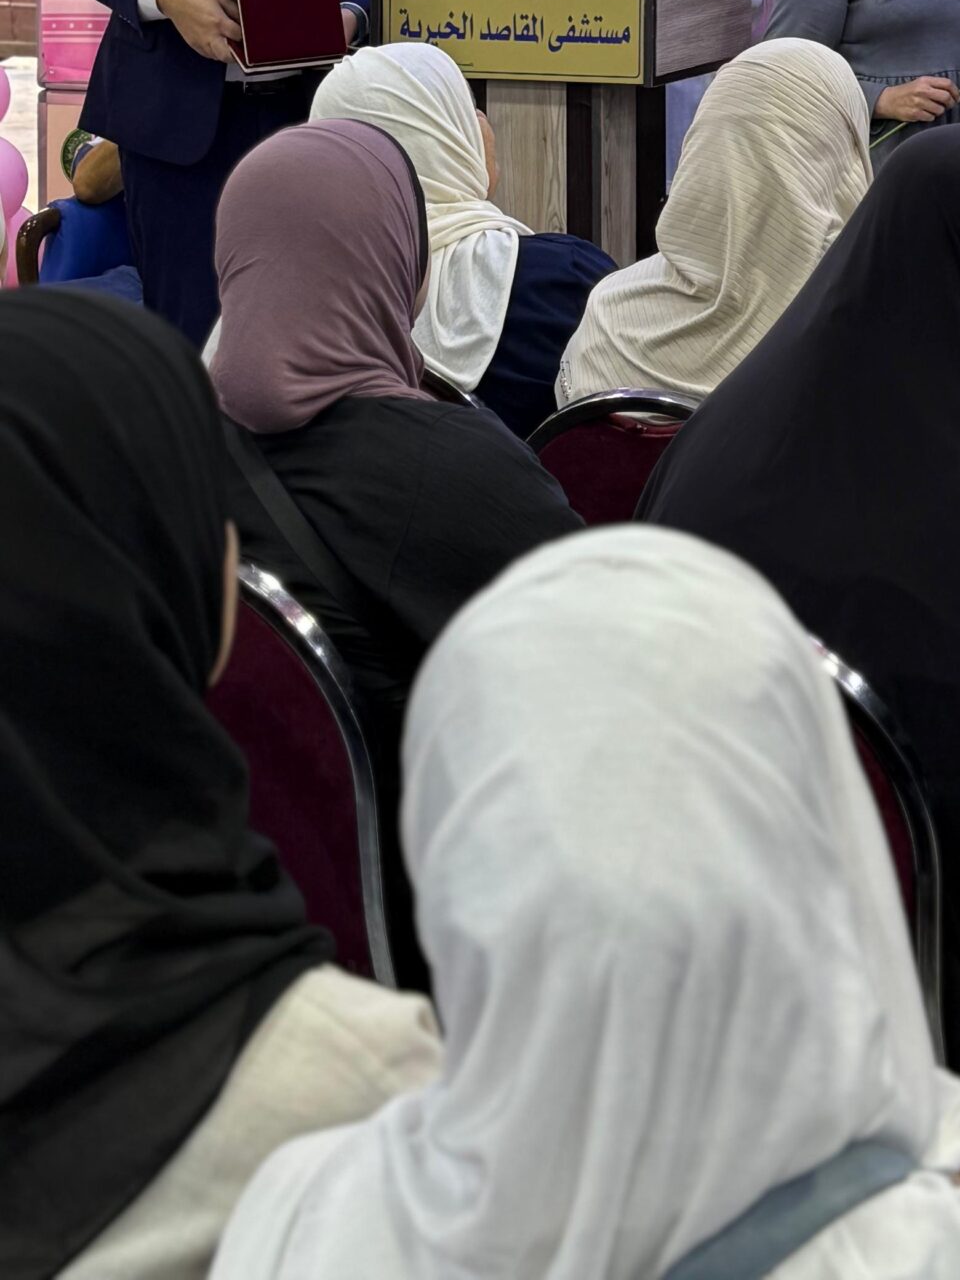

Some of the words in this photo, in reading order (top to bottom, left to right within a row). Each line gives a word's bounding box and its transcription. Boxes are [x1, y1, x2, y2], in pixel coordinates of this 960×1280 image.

[400, 7, 475, 47] الخيرية
[480, 12, 544, 42] المقاصد
[547, 14, 631, 53] مستشفى
